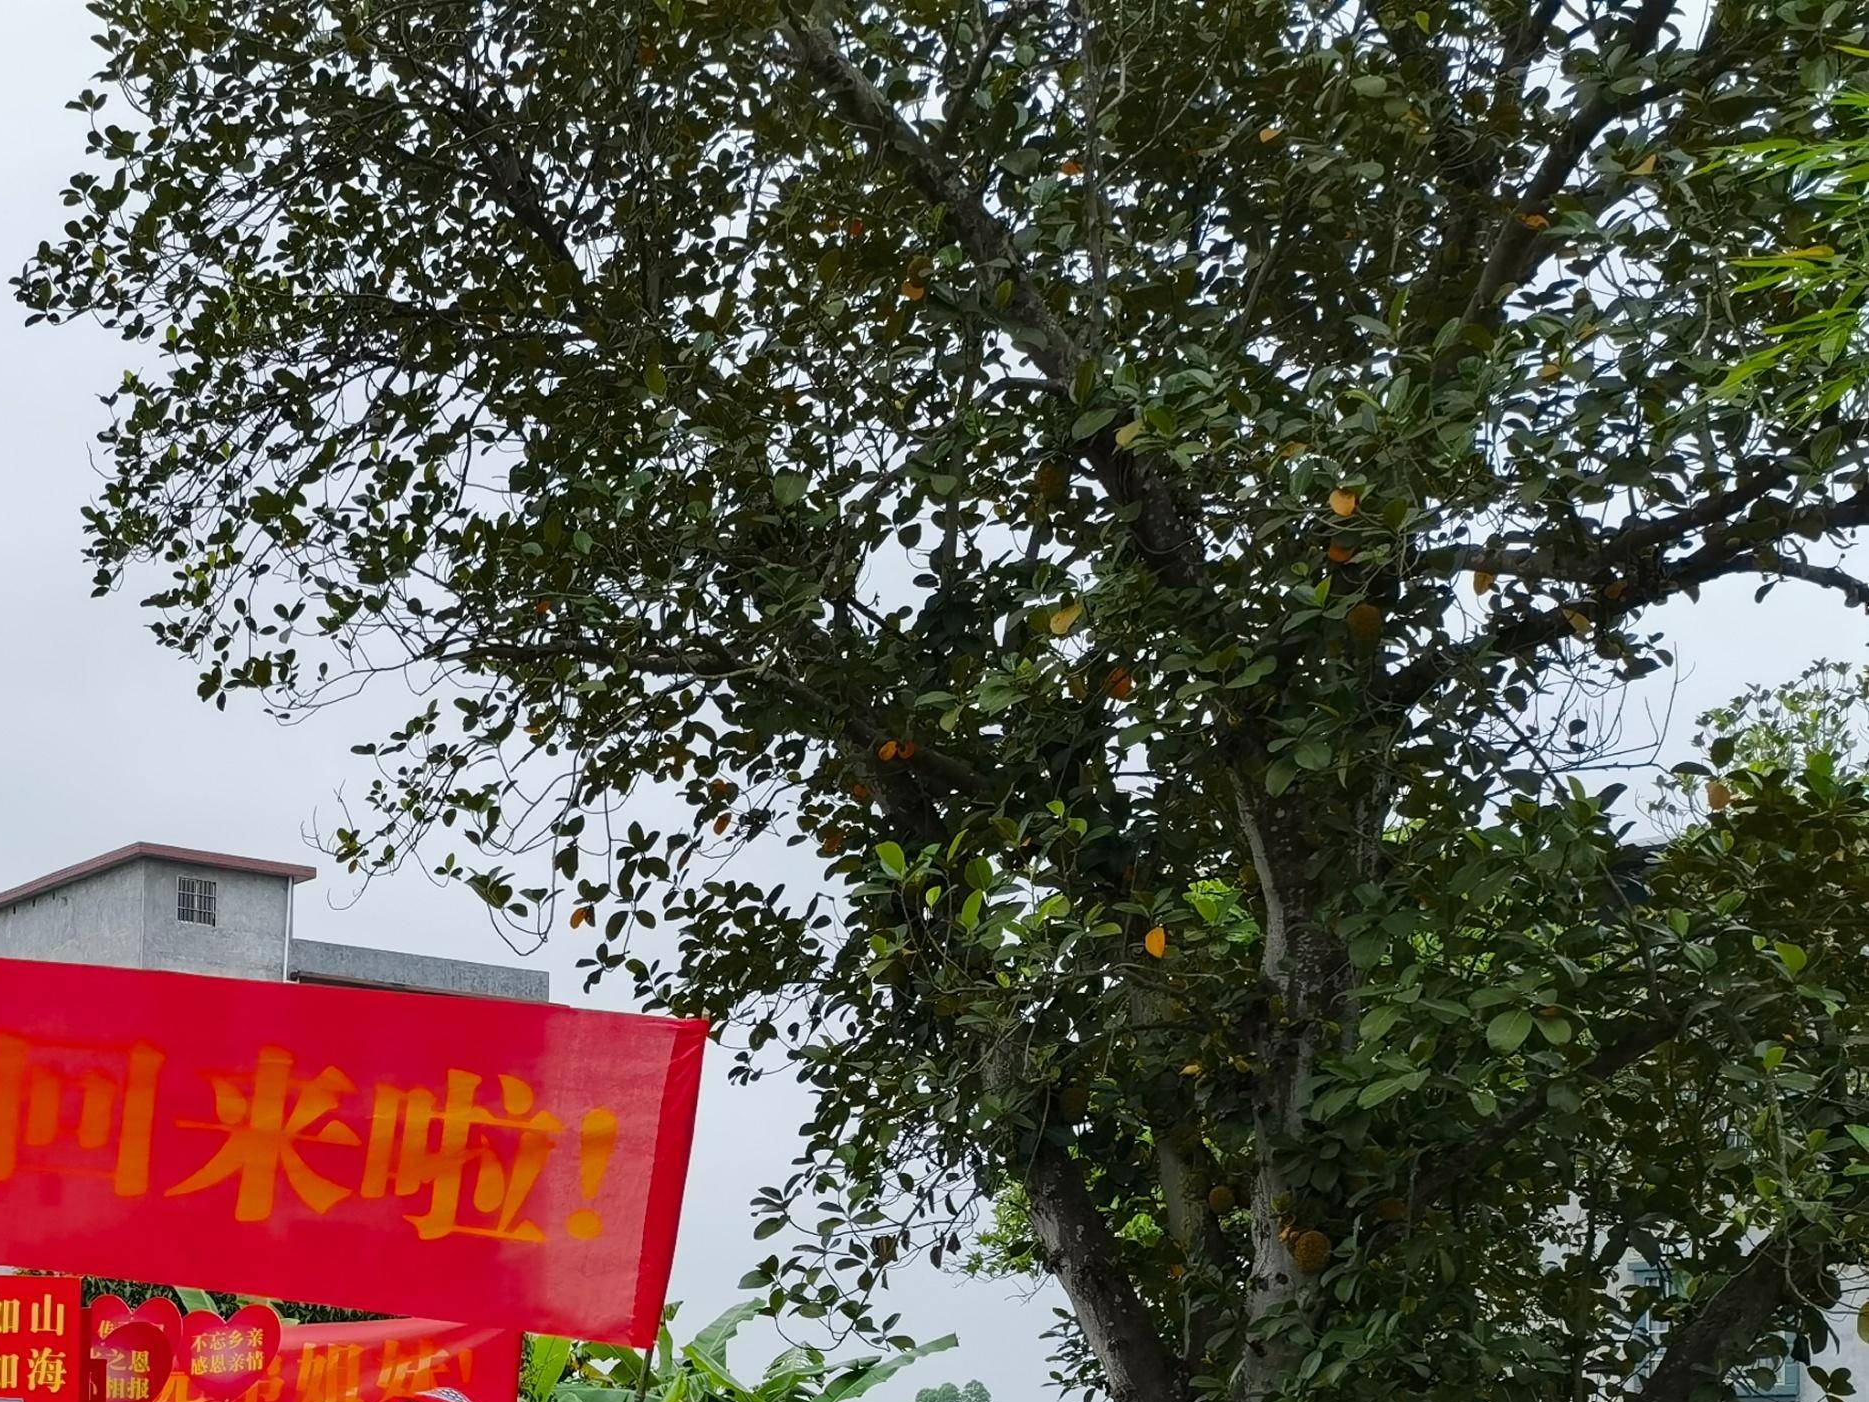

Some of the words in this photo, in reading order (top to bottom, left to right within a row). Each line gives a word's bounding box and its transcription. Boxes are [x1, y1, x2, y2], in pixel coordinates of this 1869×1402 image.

[191, 1327, 264, 1353] 不忘乡亲
[191, 1350, 264, 1376] 感恩亲情
